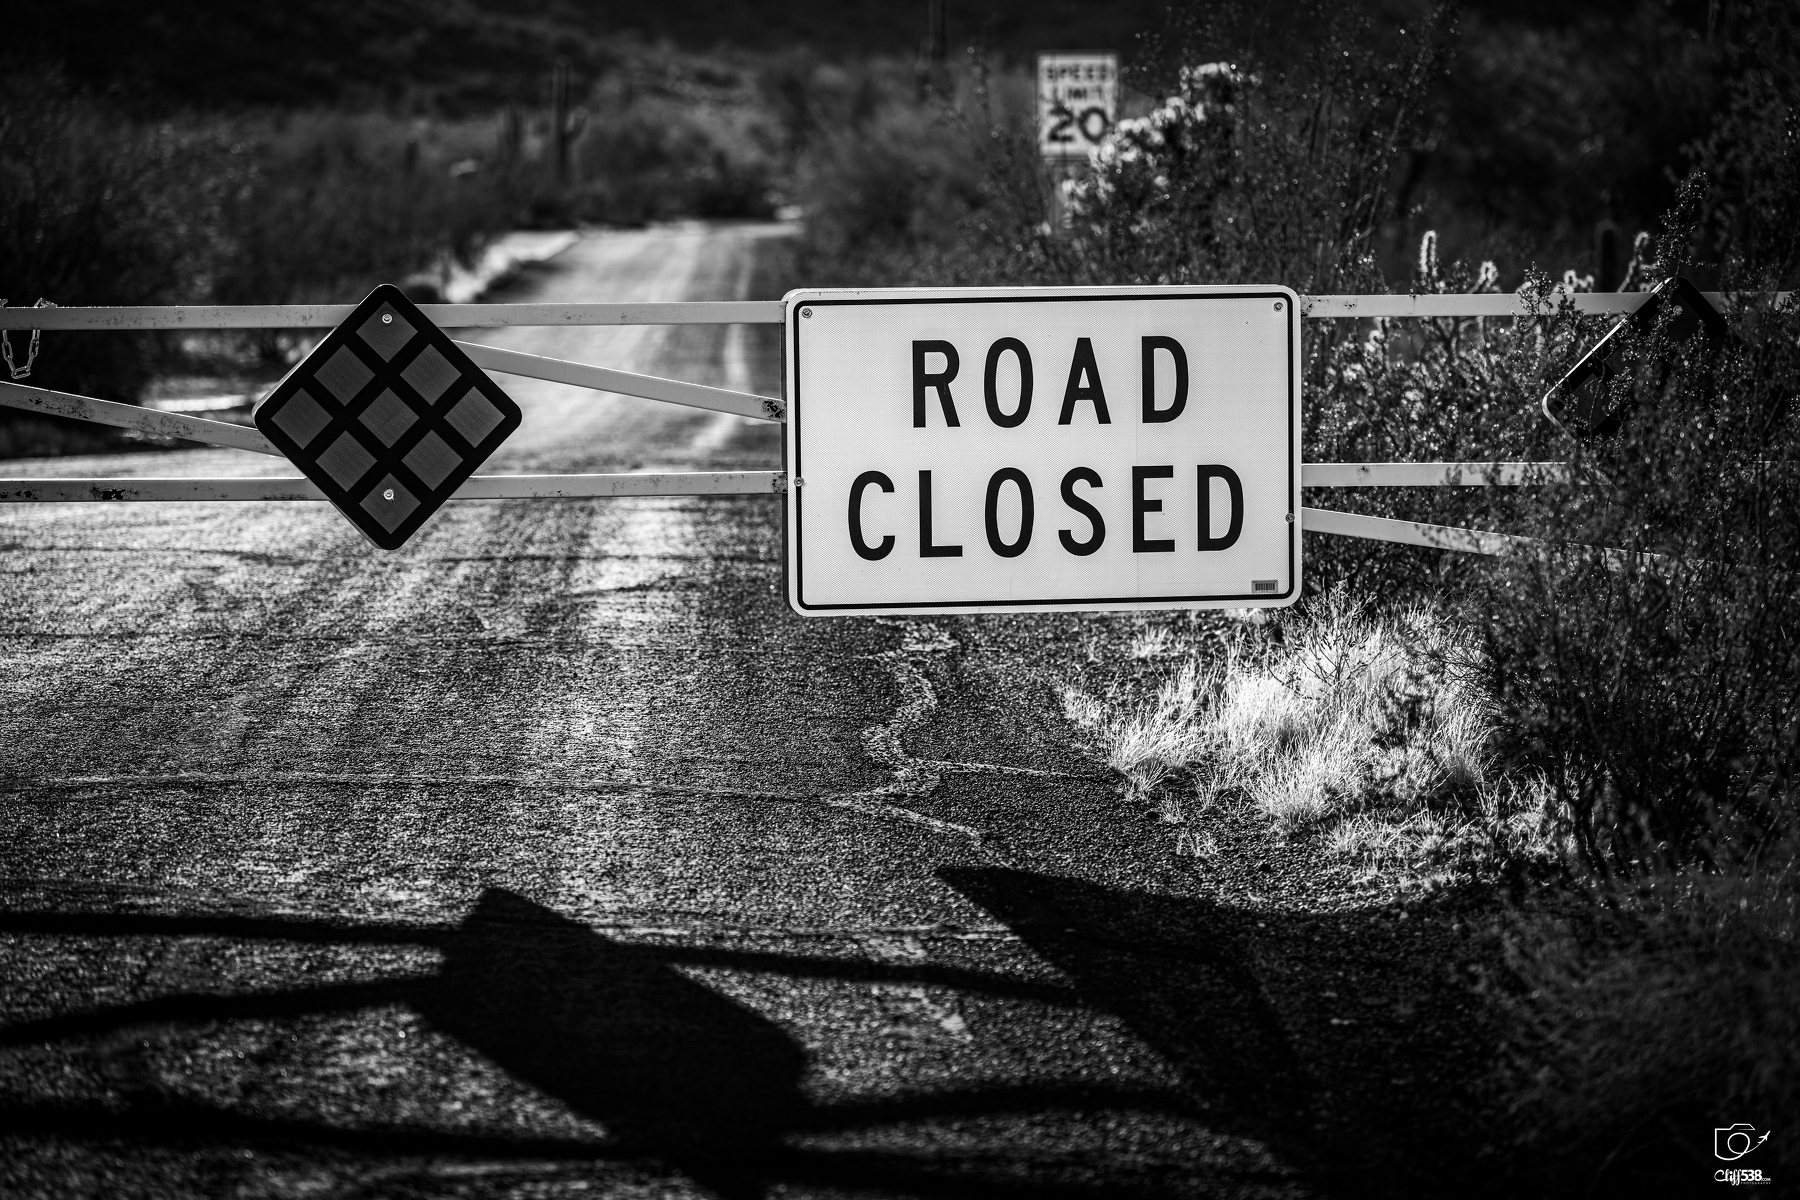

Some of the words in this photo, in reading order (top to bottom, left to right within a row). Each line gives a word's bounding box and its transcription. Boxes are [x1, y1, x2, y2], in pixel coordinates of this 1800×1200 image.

[1044, 64, 1109, 81] SPEED
[1047, 105, 1110, 144] 20
[912, 336, 1189, 429] ROAD
[847, 464, 1245, 562] CLOSED
